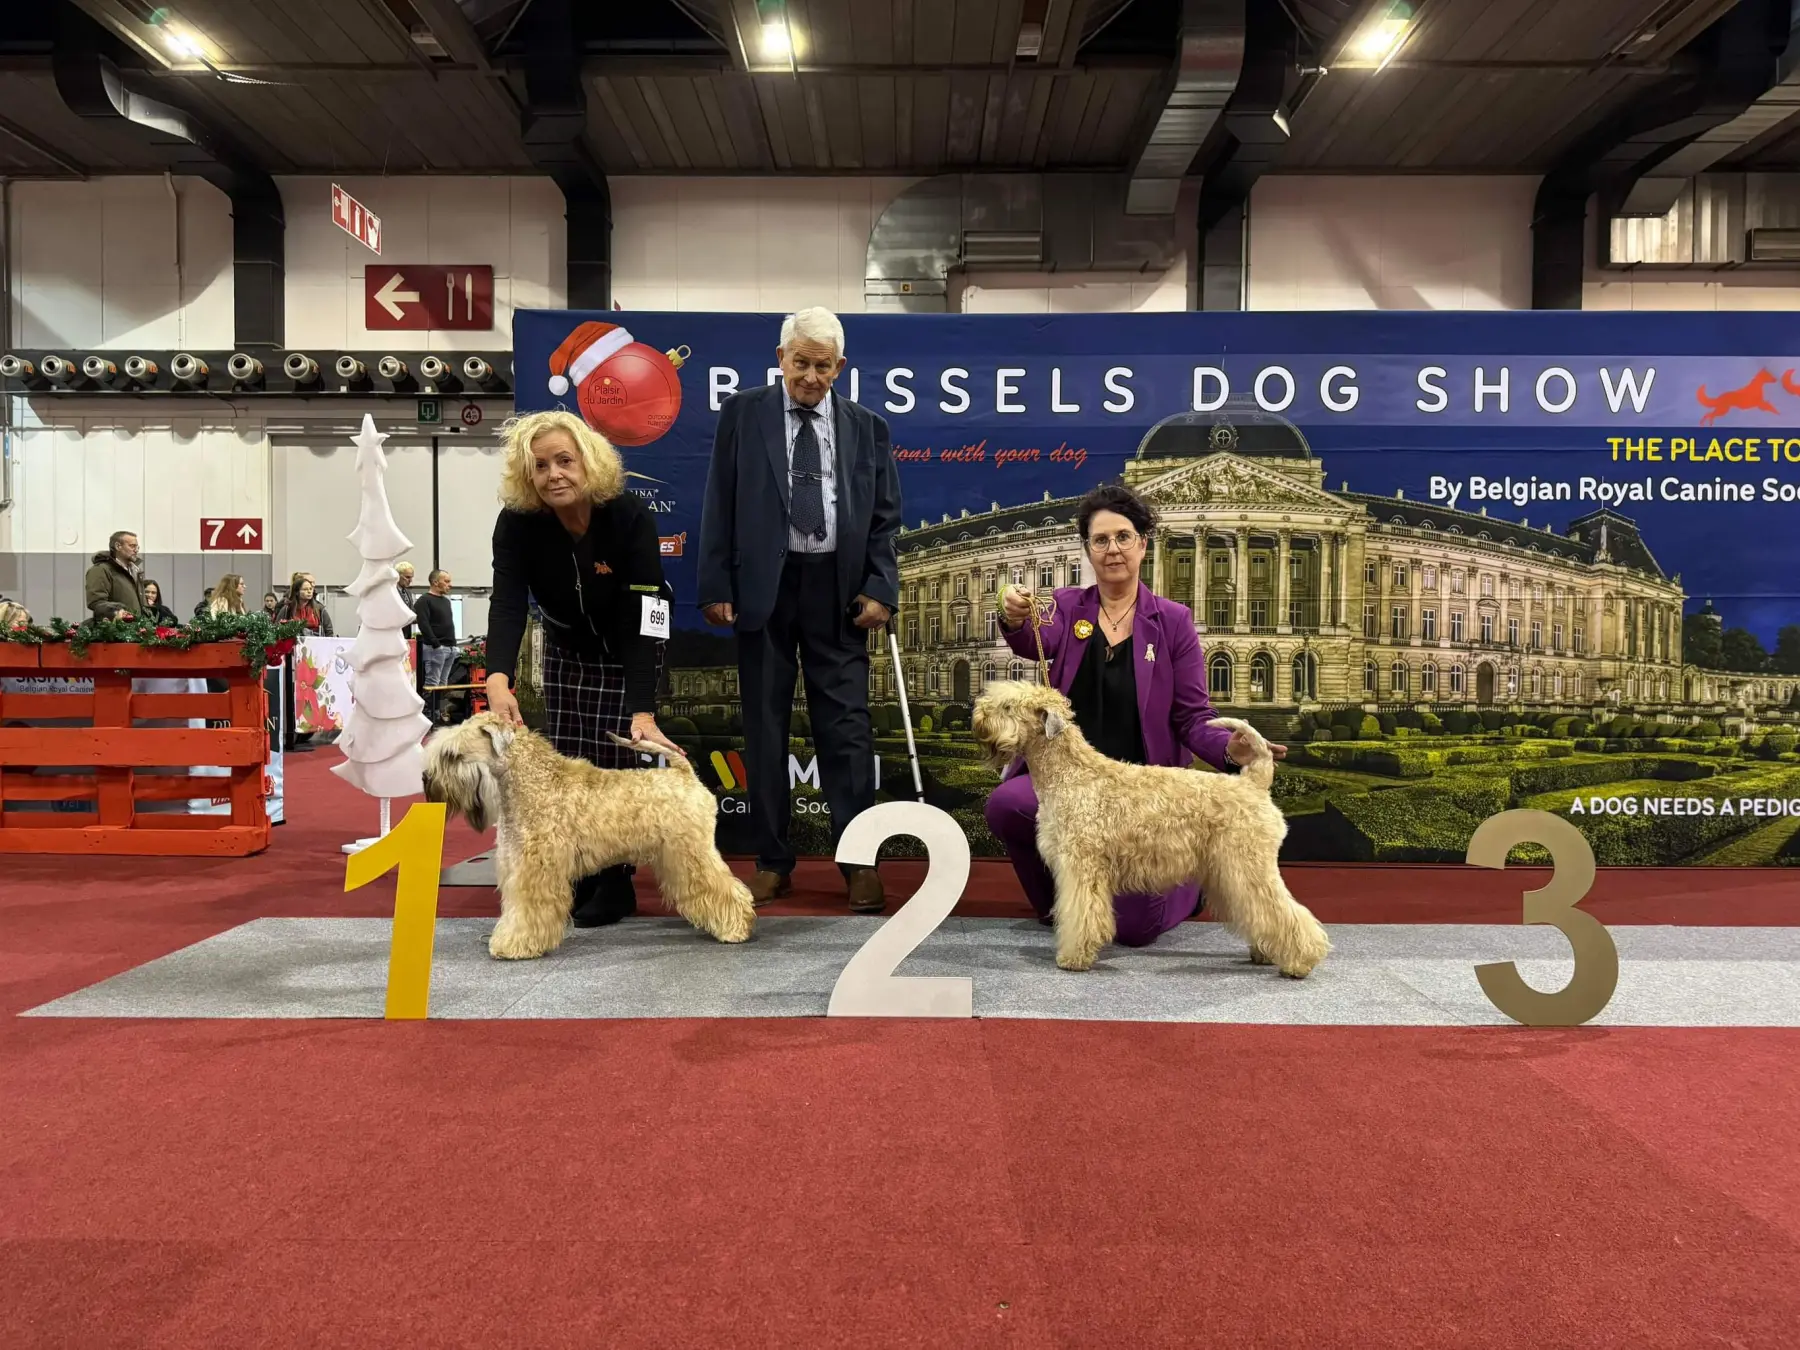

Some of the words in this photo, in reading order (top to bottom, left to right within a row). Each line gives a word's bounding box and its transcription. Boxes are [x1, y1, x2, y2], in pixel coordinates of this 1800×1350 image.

[594, 385, 620, 395] Plaisir
[596, 396, 624, 405] Jardin
[1193, 366, 1360, 413] DOG
[1416, 366, 1656, 413] SHOW
[891, 443, 931, 462] ions
[940, 438, 987, 462] with
[994, 445, 1041, 470] your
[1049, 441, 1088, 470] dog
[1606, 438, 1662, 462] THE
[1670, 438, 1760, 462] PLACE
[1430, 476, 1463, 506] By
[1469, 476, 1571, 506] Belgian
[1579, 477, 1652, 506] Royal
[1660, 477, 1755, 502] Canine
[1762, 478, 1800, 502] So
[648, 500, 672, 512] AN
[206, 520, 225, 546] 7
[660, 541, 676, 553] ES
[650, 610, 665, 625] 699
[1570, 797, 1585, 815] A
[1590, 797, 1638, 815] DOG
[1644, 797, 1715, 816] NEEDS
[1720, 797, 1735, 816] A
[344, 803, 447, 1019] 1
[827, 801, 973, 1017] 2
[1465, 808, 1619, 1026] 3
